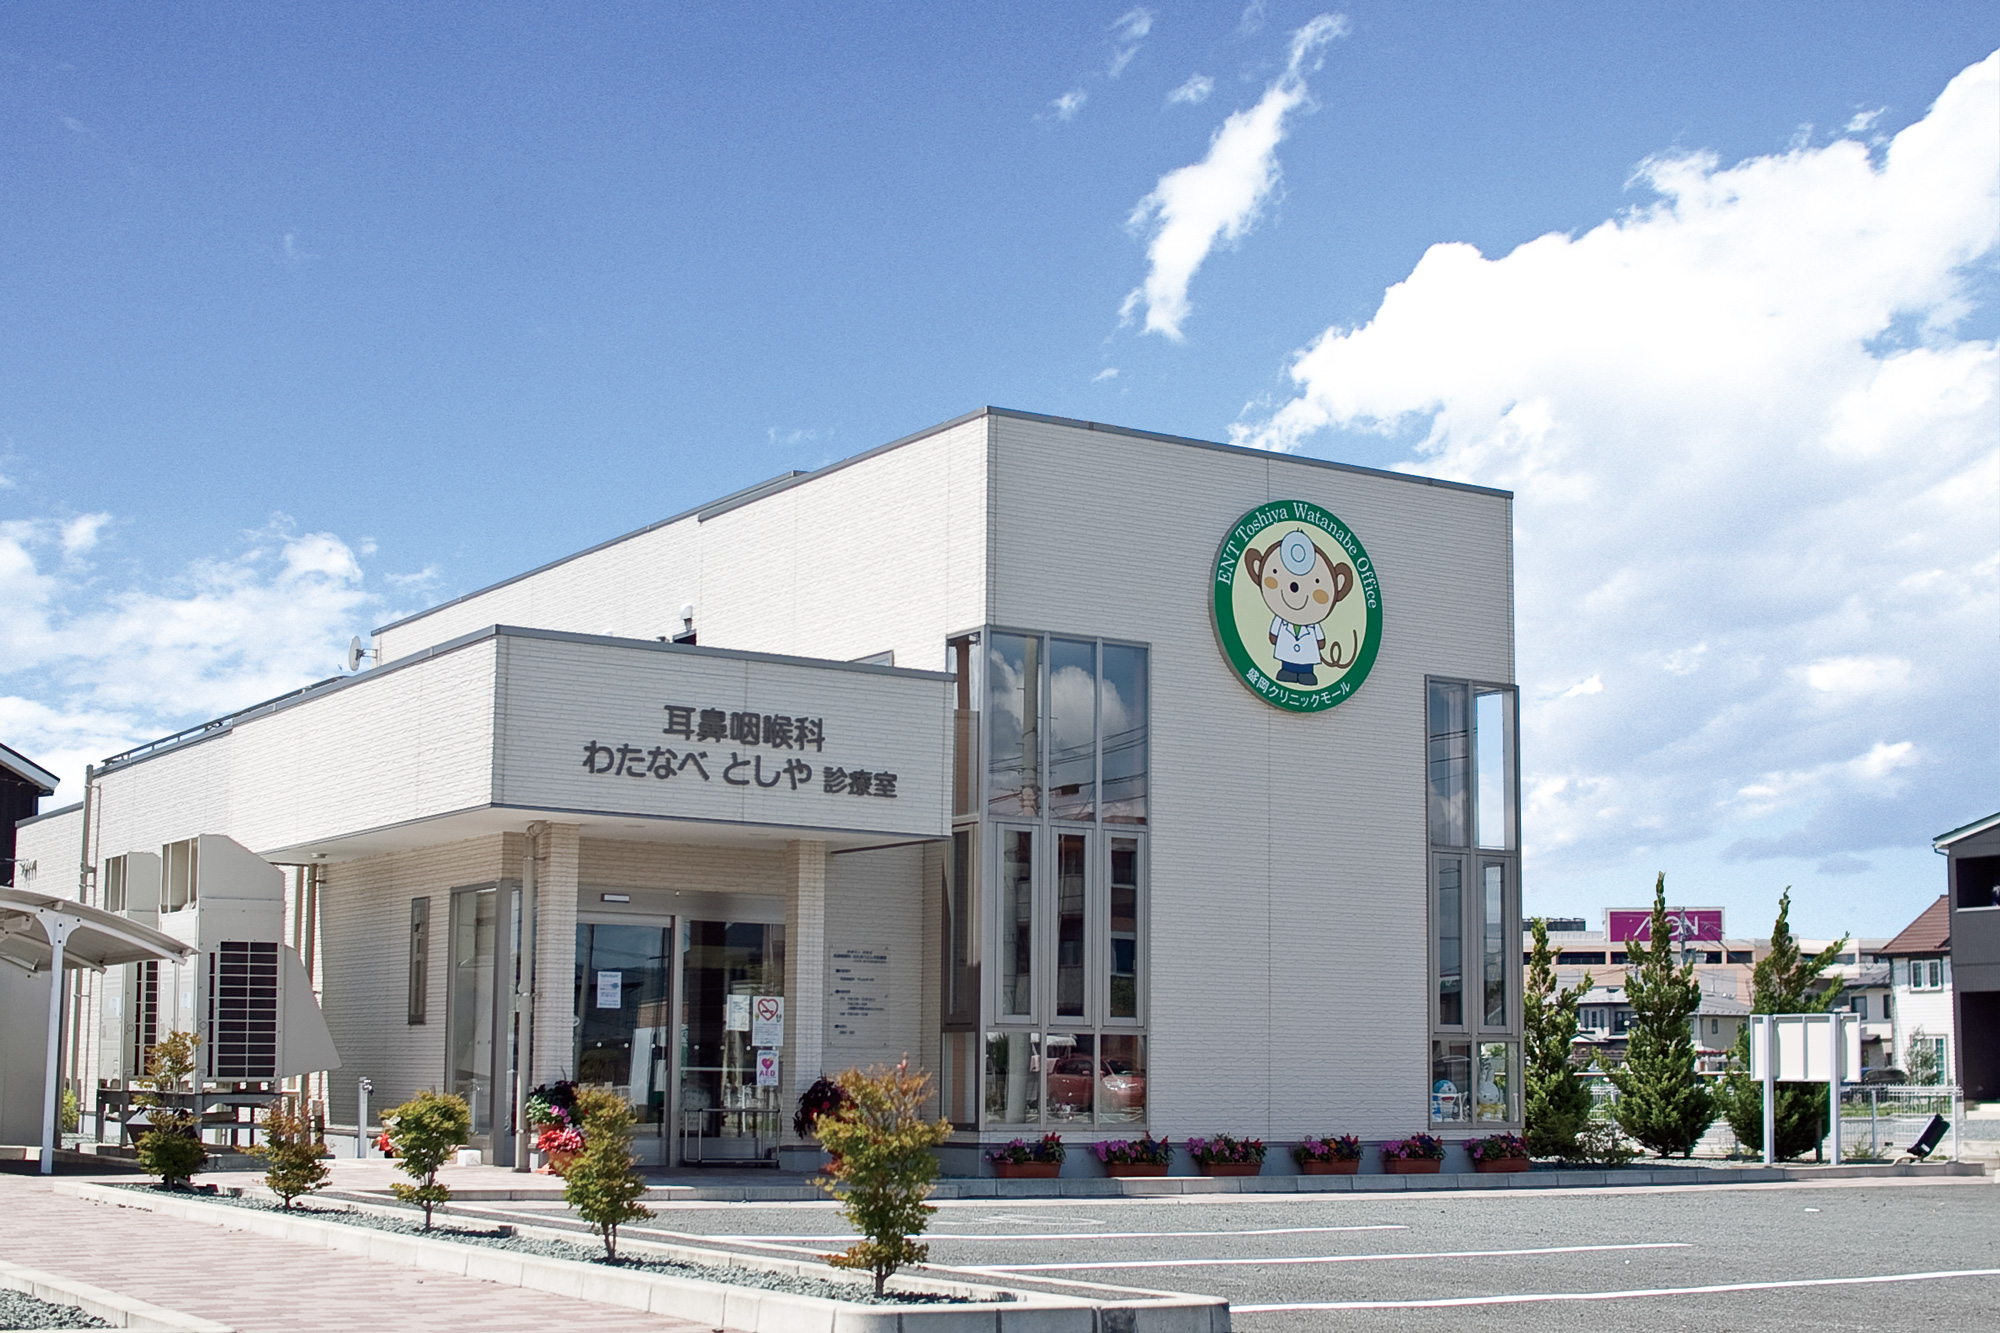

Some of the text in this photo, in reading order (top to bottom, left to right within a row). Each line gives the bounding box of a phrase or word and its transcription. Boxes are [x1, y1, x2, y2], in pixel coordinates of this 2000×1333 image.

[1217, 502, 1378, 609] ENT Toshiya Watanabe Office
[1245, 667, 1351, 708] 盛岡クリニックモール
[662, 704, 826, 753] 耳鼻咽喉科
[582, 739, 898, 798] わたなべ としや 診療室
